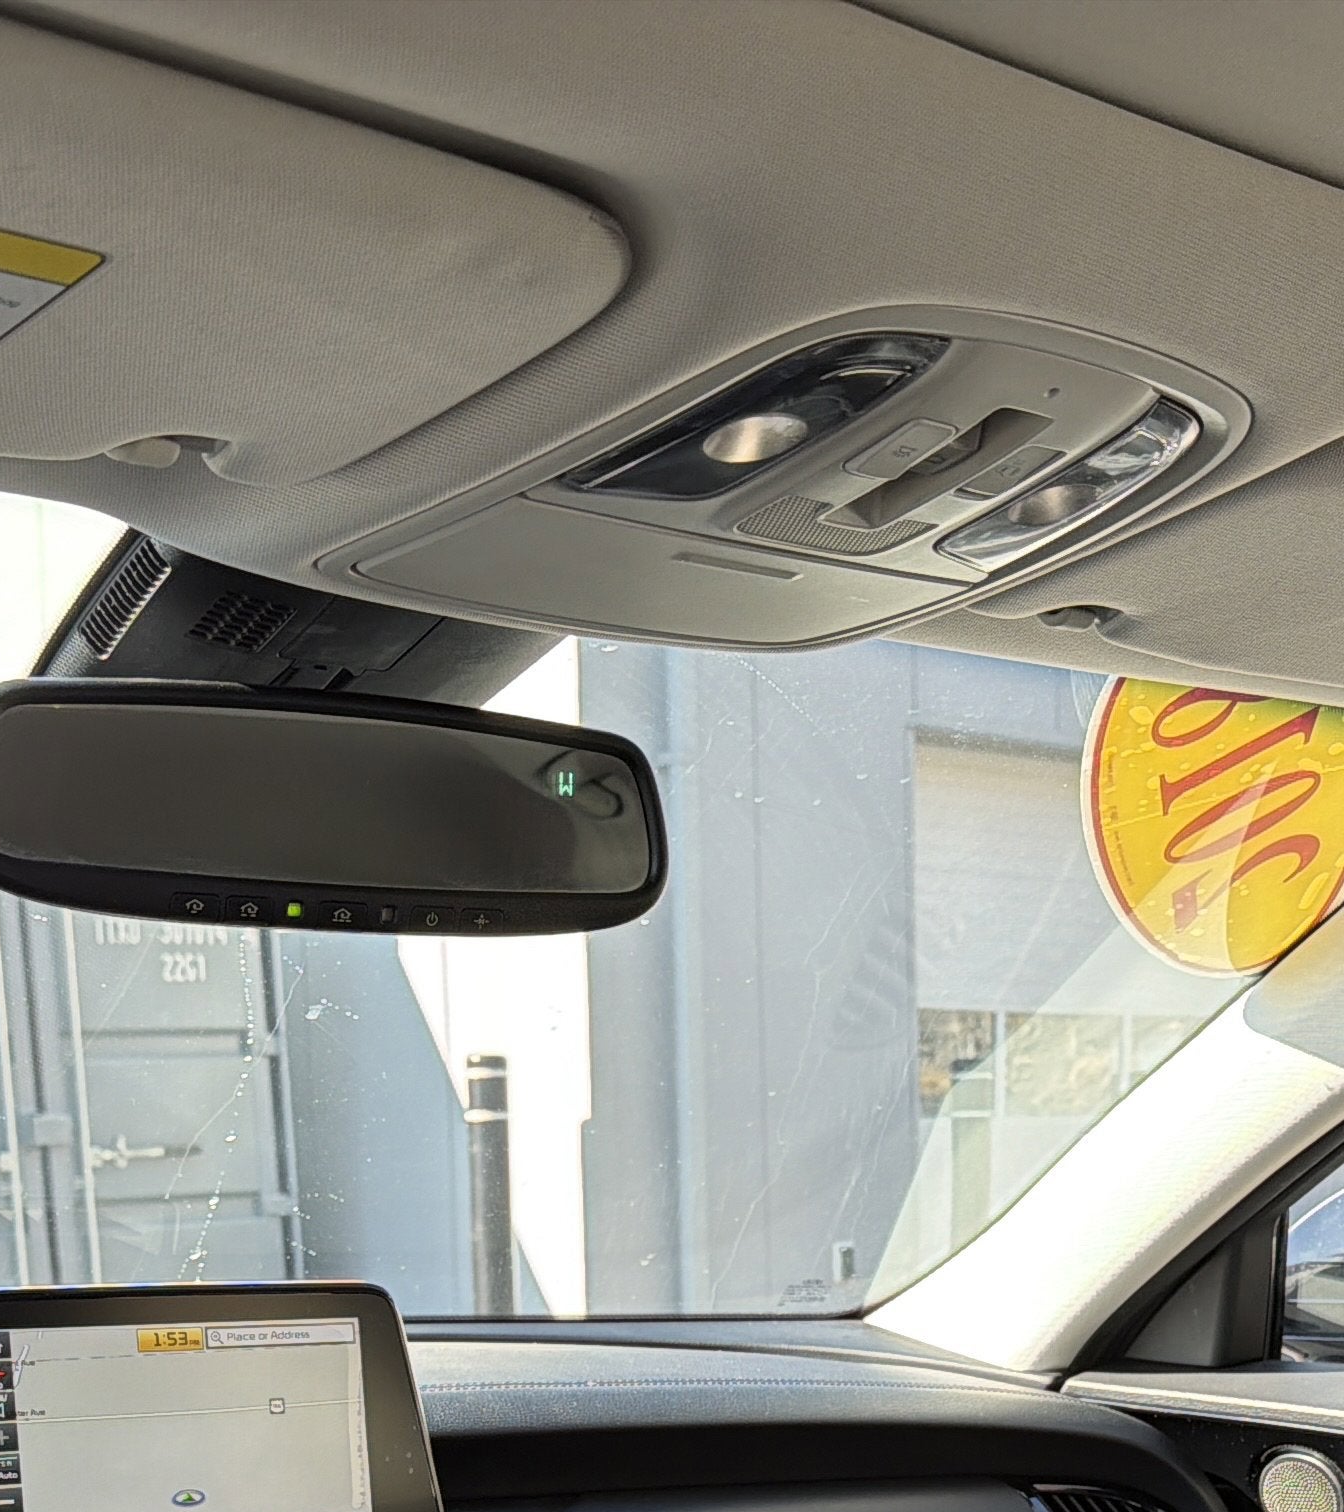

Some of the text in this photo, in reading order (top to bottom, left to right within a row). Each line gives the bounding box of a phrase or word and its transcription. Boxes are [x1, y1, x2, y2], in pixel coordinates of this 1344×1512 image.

[558, 771, 573, 797] W
[153, 1331, 189, 1347] 1:53
[226, 1330, 310, 1342] Place or Address
